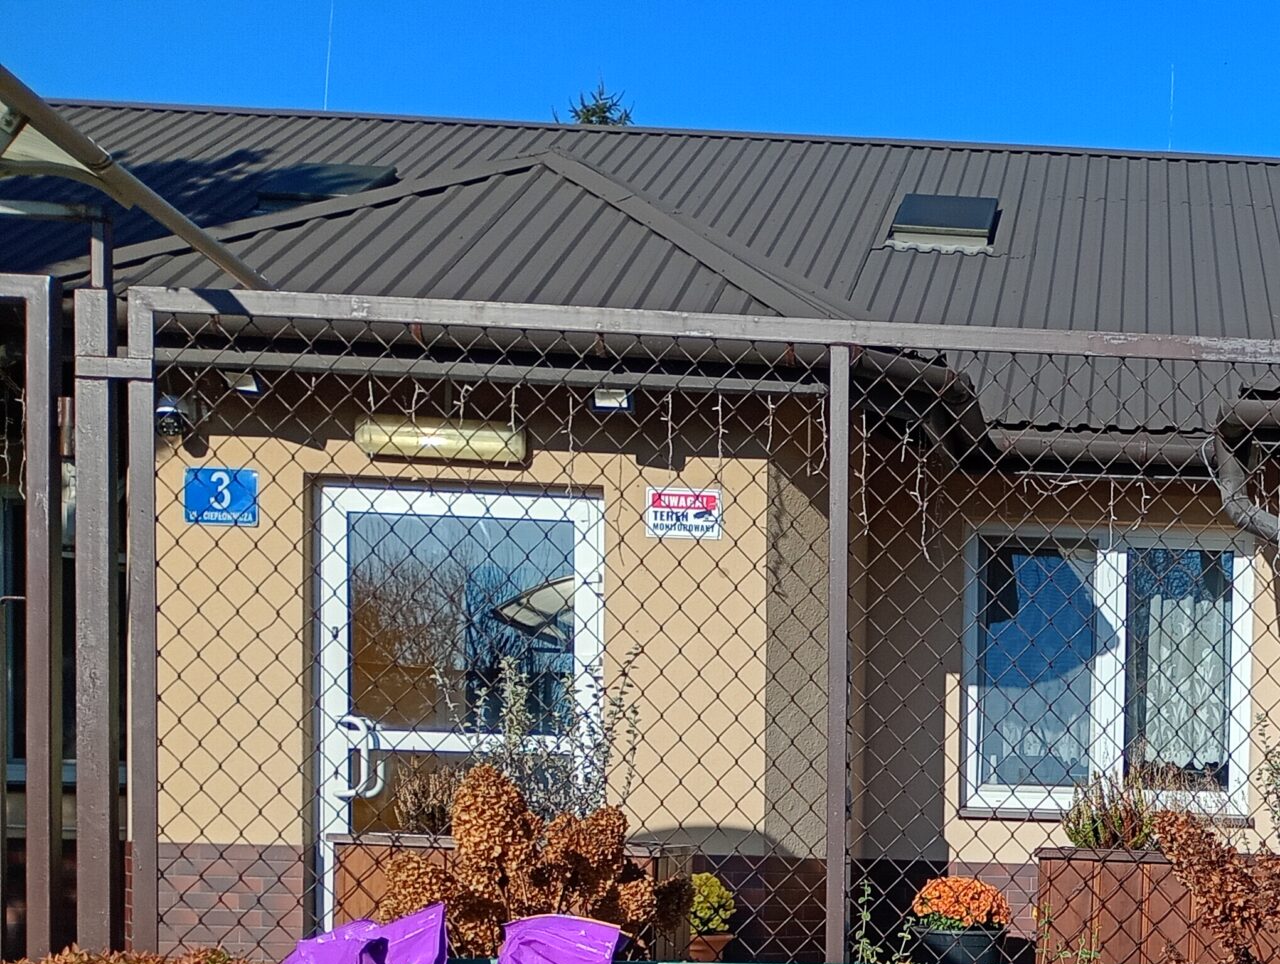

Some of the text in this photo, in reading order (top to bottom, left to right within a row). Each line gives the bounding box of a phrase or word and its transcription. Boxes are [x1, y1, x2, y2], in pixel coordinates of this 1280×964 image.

[209, 471, 231, 510] 3
[661, 495, 707, 508] UWAGA!
[653, 511, 688, 521] TEREN
